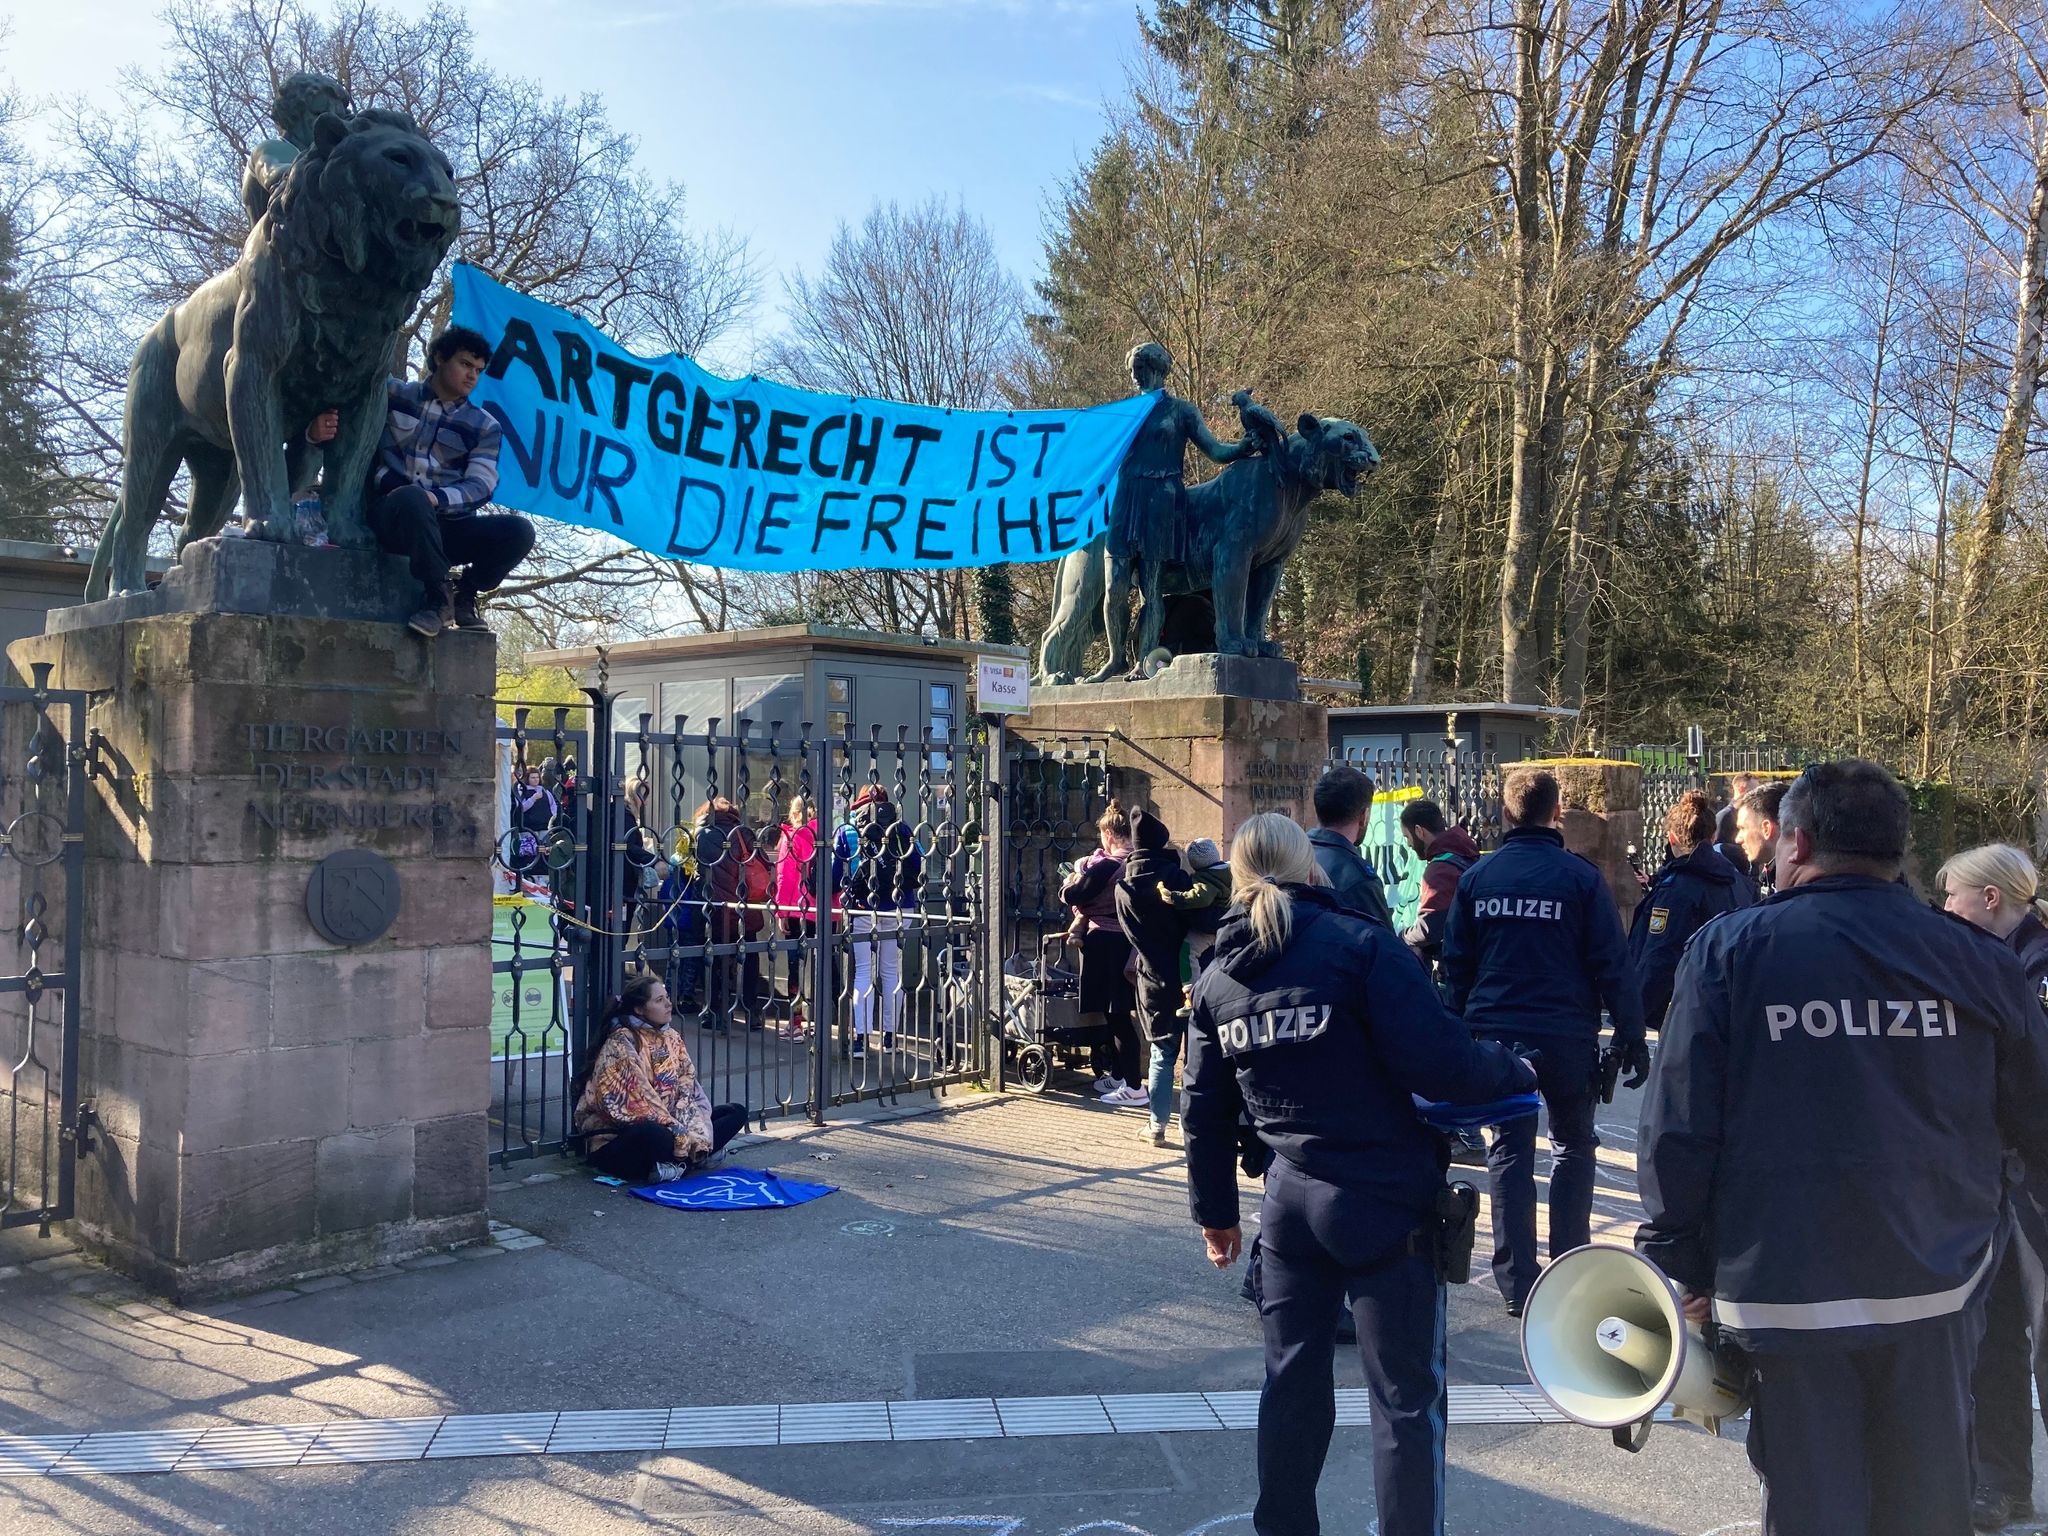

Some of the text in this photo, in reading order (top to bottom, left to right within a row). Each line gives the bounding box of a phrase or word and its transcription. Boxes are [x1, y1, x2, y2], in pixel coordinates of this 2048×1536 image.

[485, 317, 1065, 490] ARTGERECHT IST
[482, 400, 637, 526] NUR
[992, 681, 1017, 694] Kasse
[241, 723, 461, 754] TIERGARTEN
[257, 762, 440, 791] DER STADT
[1475, 898, 1562, 920] POLIZEI
[1218, 1004, 1332, 1053] POLIZEI
[1766, 999, 1957, 1042] POLIZEI
